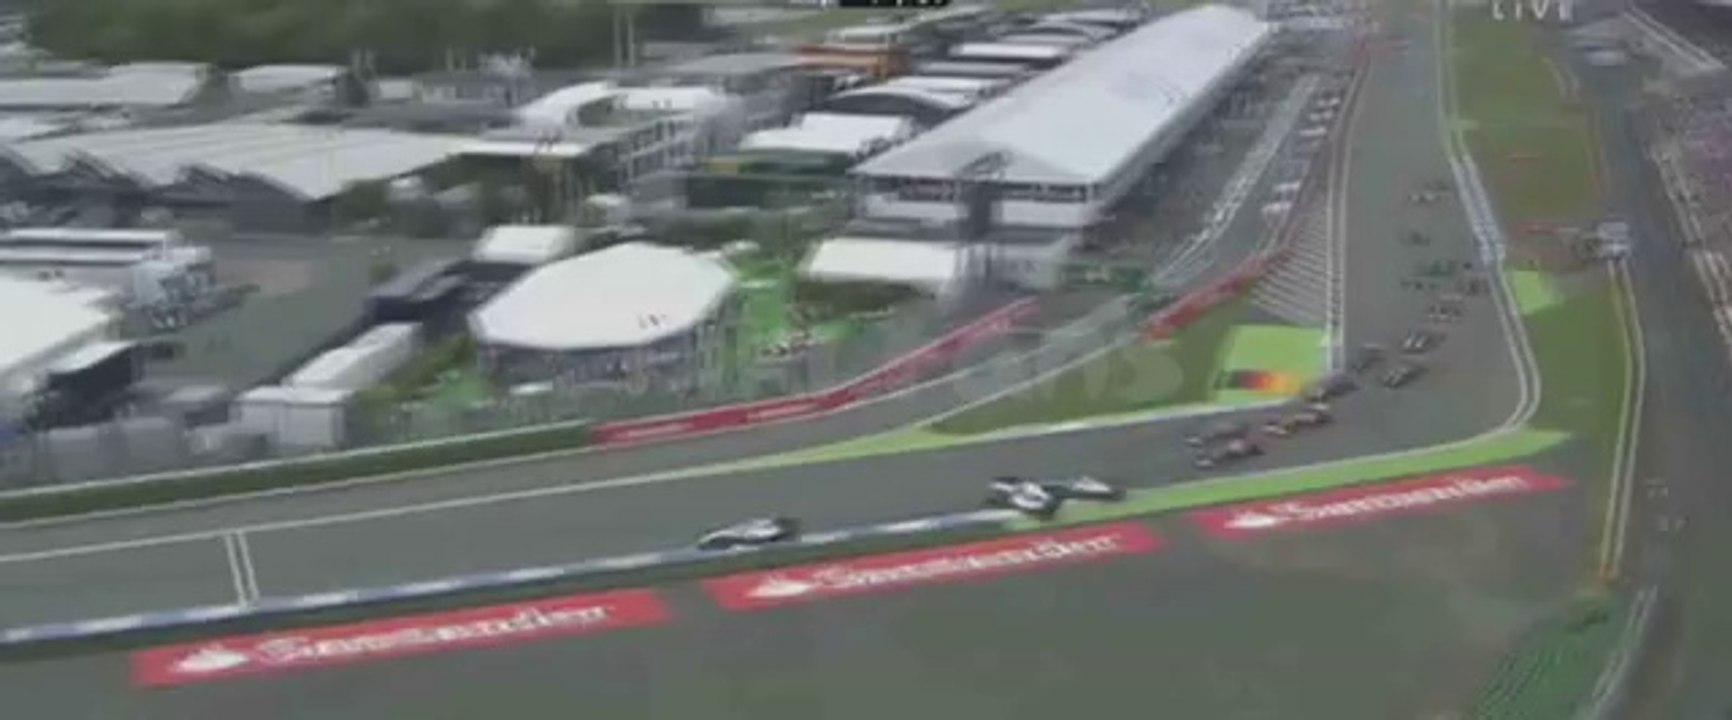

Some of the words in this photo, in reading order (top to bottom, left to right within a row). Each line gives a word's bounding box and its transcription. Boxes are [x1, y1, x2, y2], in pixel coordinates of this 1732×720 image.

[1271, 472, 1526, 521] Santander
[812, 534, 1121, 589] Santander
[256, 606, 608, 664] Santander
